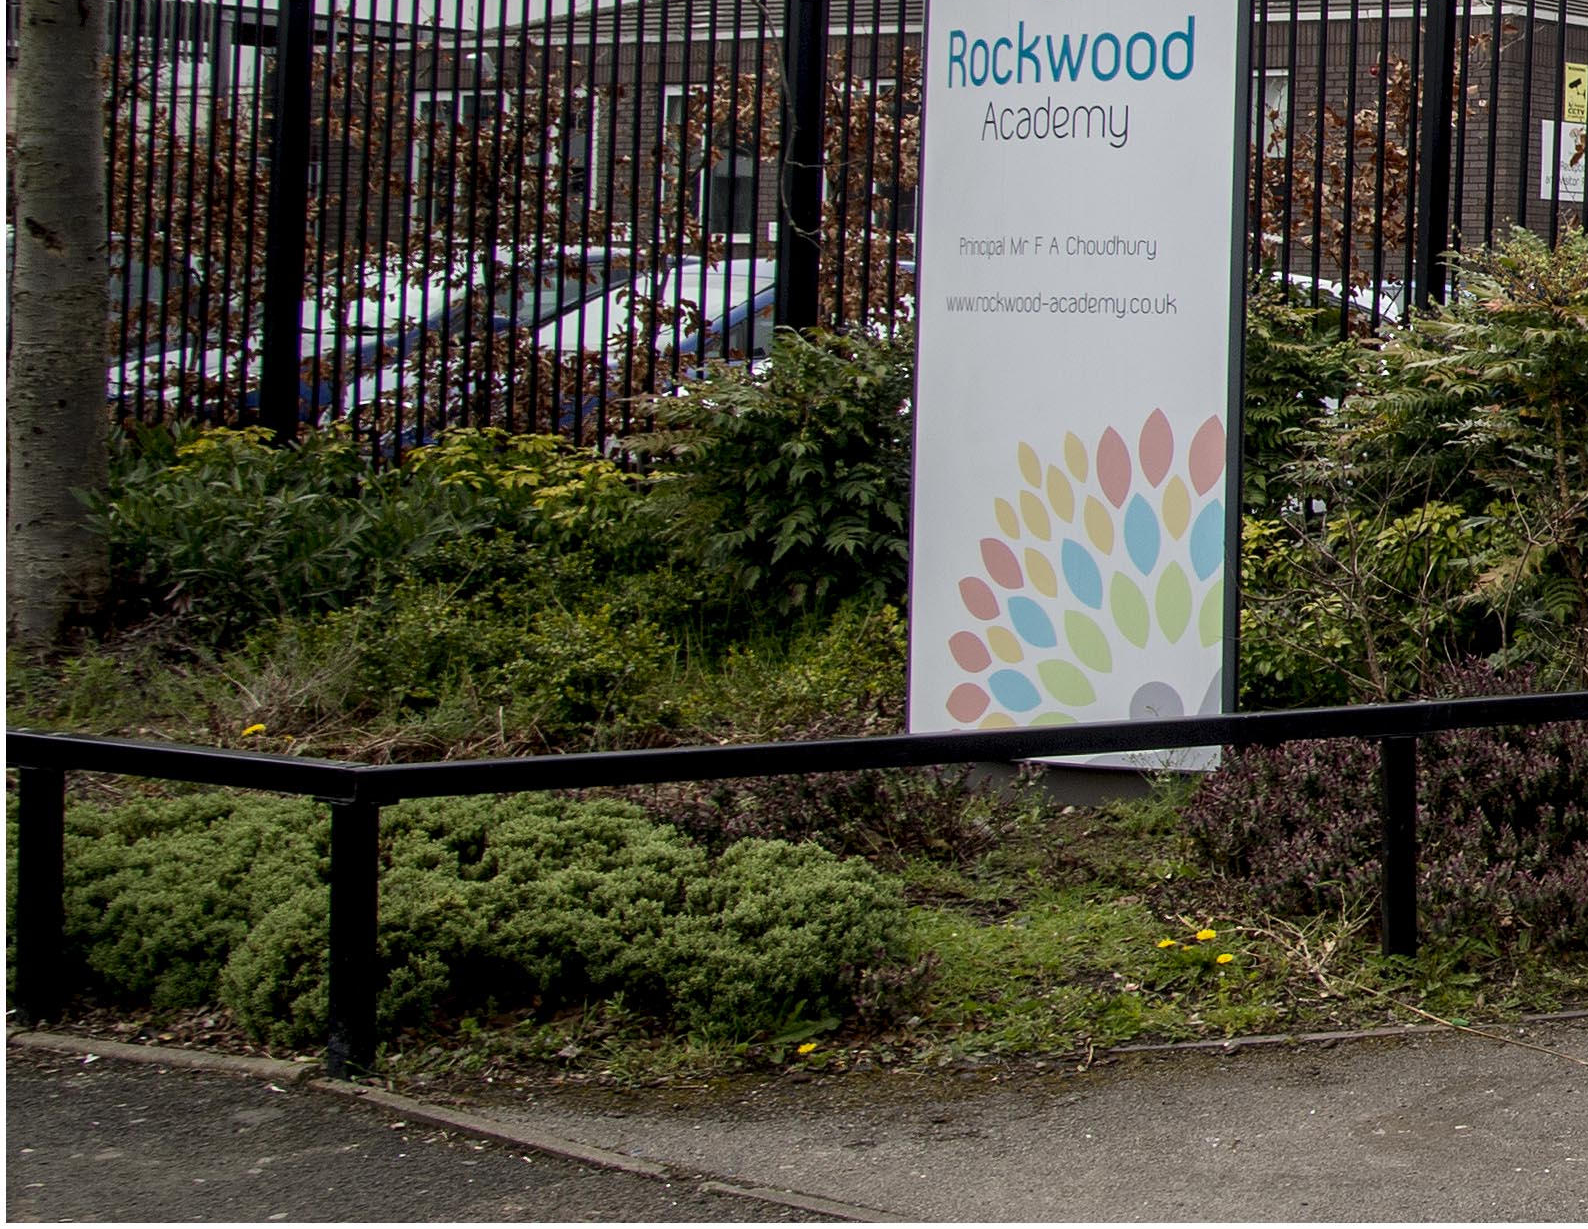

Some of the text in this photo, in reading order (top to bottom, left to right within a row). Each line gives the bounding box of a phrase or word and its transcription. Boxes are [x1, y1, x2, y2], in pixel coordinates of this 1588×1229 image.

[948, 15, 1195, 88] Rockwood
[981, 97, 1129, 148] Academy
[959, 235, 1157, 260] Principal Mr F A Choudhury
[946, 292, 1178, 318] www.rockwood-academy.co.uk
